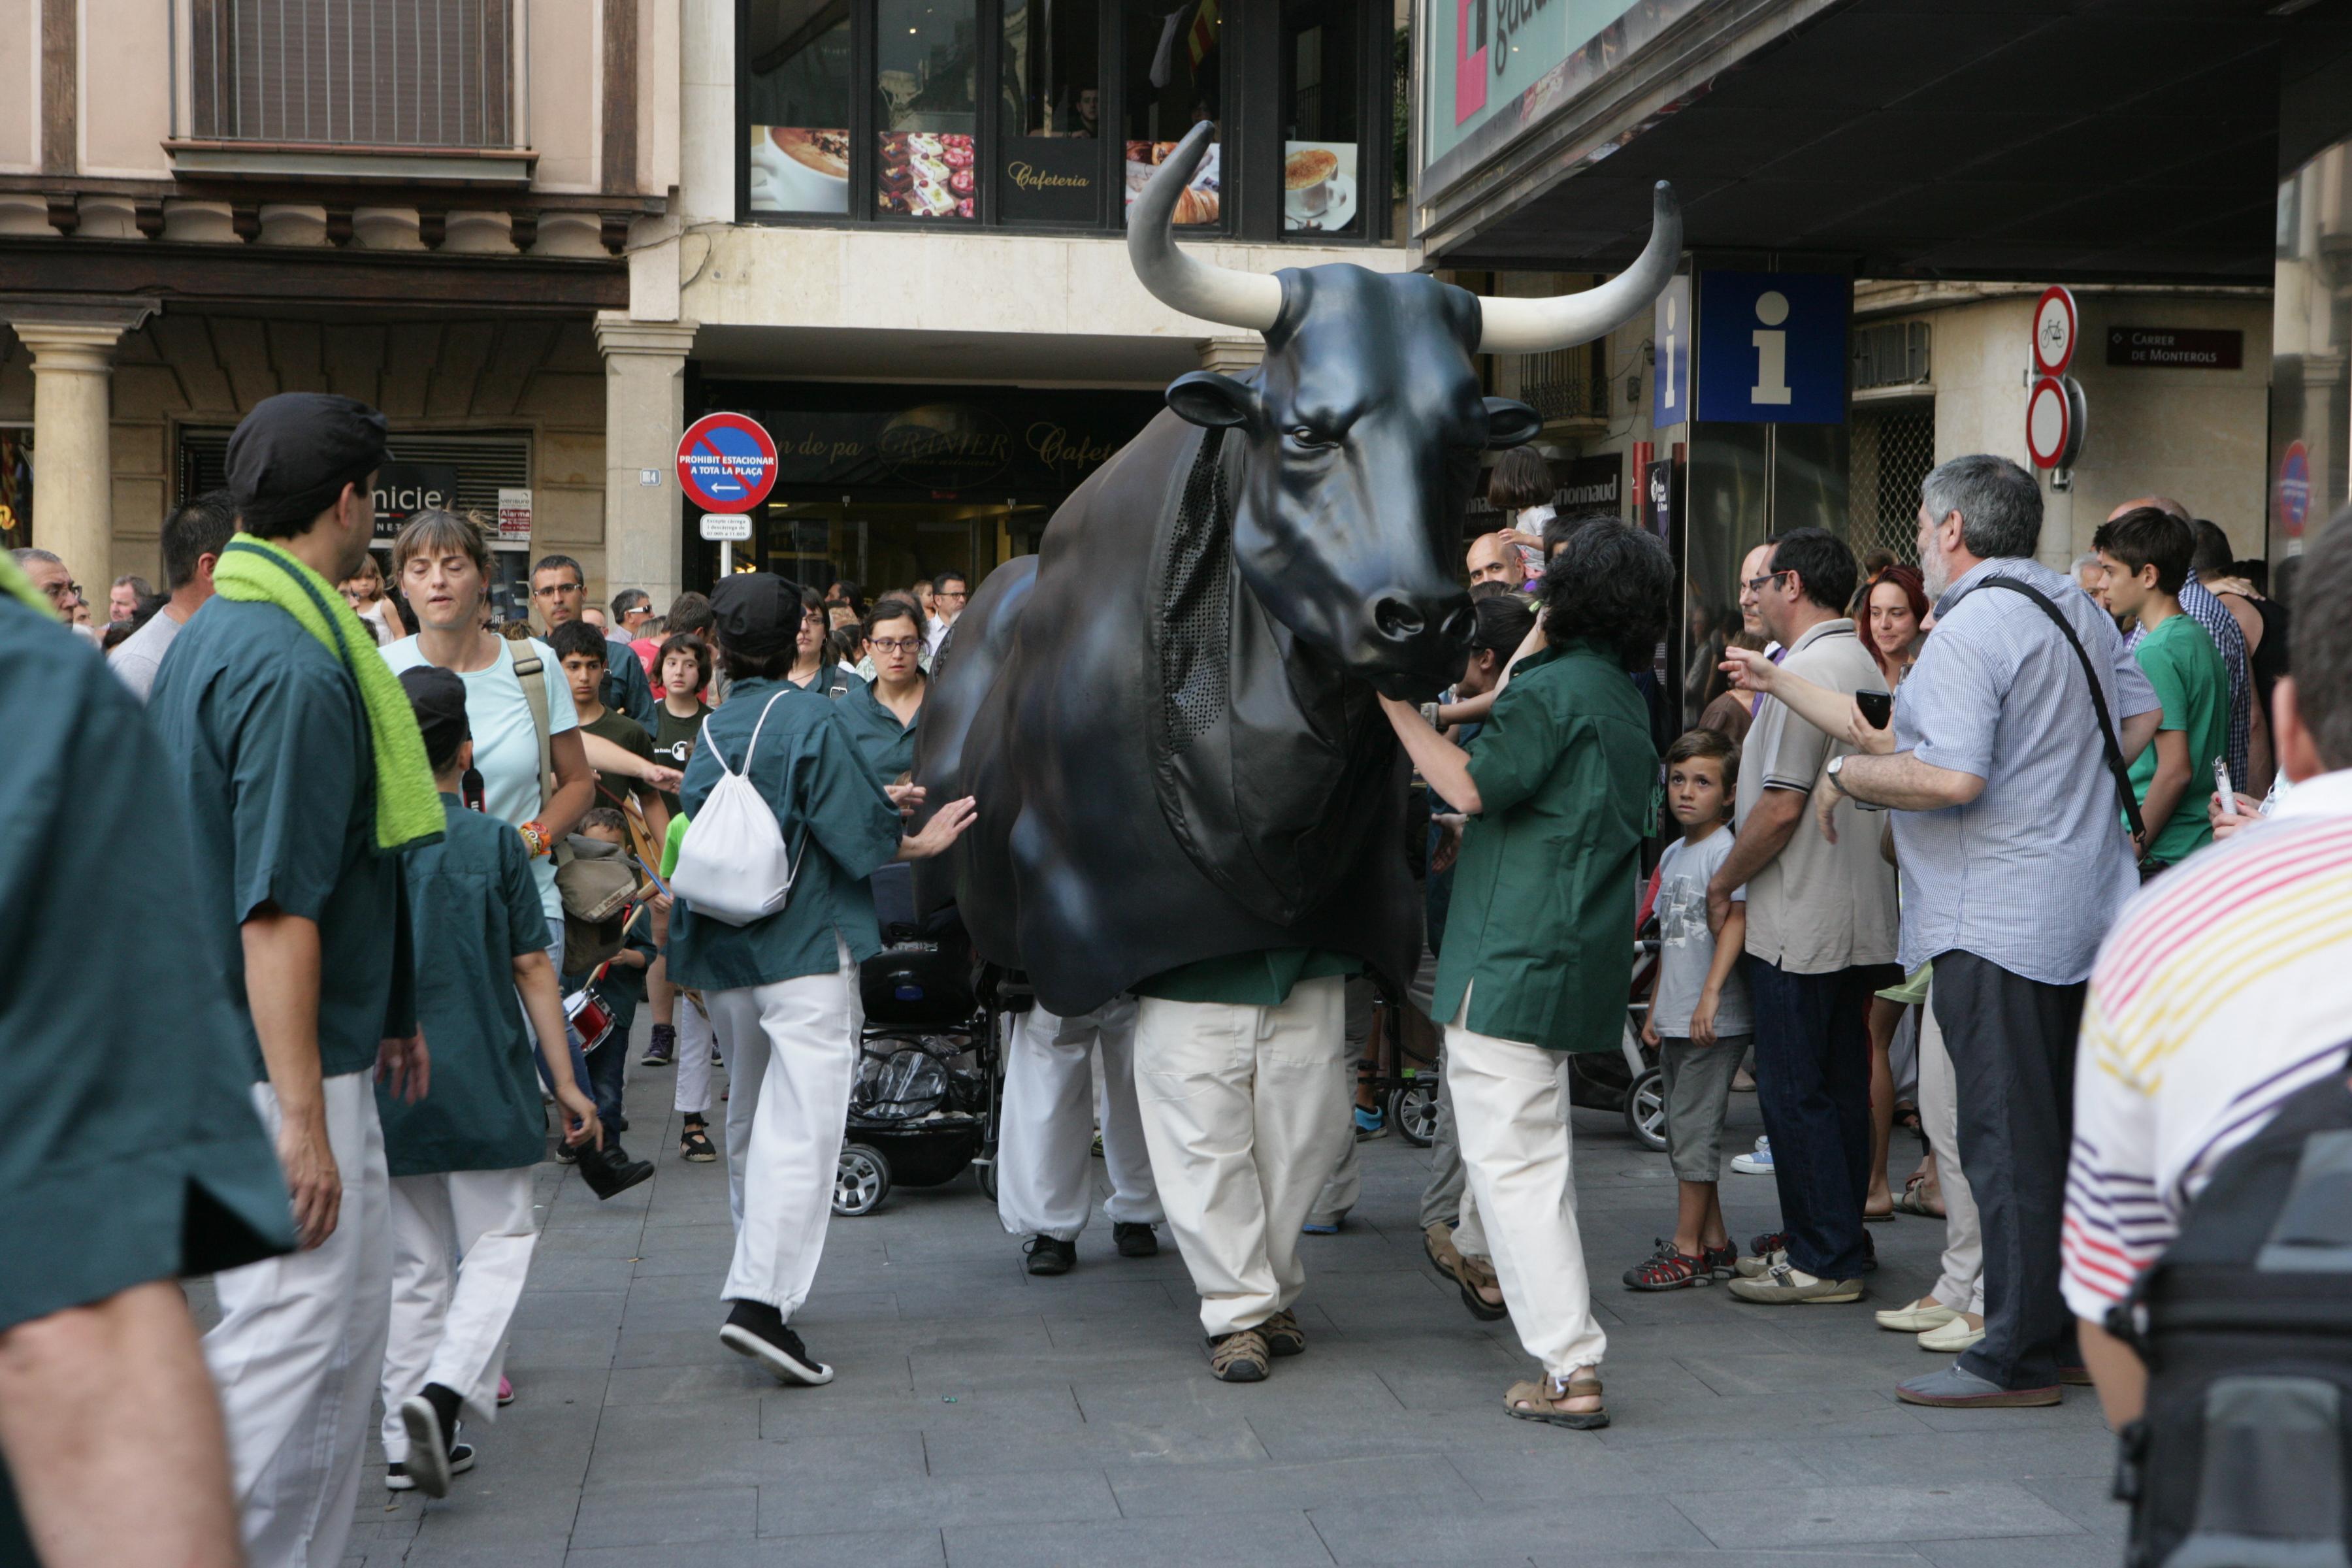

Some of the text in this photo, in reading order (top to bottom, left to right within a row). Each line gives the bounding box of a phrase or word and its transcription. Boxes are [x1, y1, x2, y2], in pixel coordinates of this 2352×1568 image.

[1008, 161, 1090, 191] Cafeteria
[1751, 291, 1791, 404] i
[679, 455, 774, 465] PROHIBIT ESTACIONAR
[798, 431, 829, 455] de
[829, 440, 864, 465] pa
[877, 430, 1010, 461] GRANIER
[1026, 421, 1116, 470] Cafet
[699, 466, 720, 475] TOTA
[735, 467, 763, 477] PLAÇA
[1551, 473, 1617, 506] arionnaud
[376, 523, 403, 532] NET
